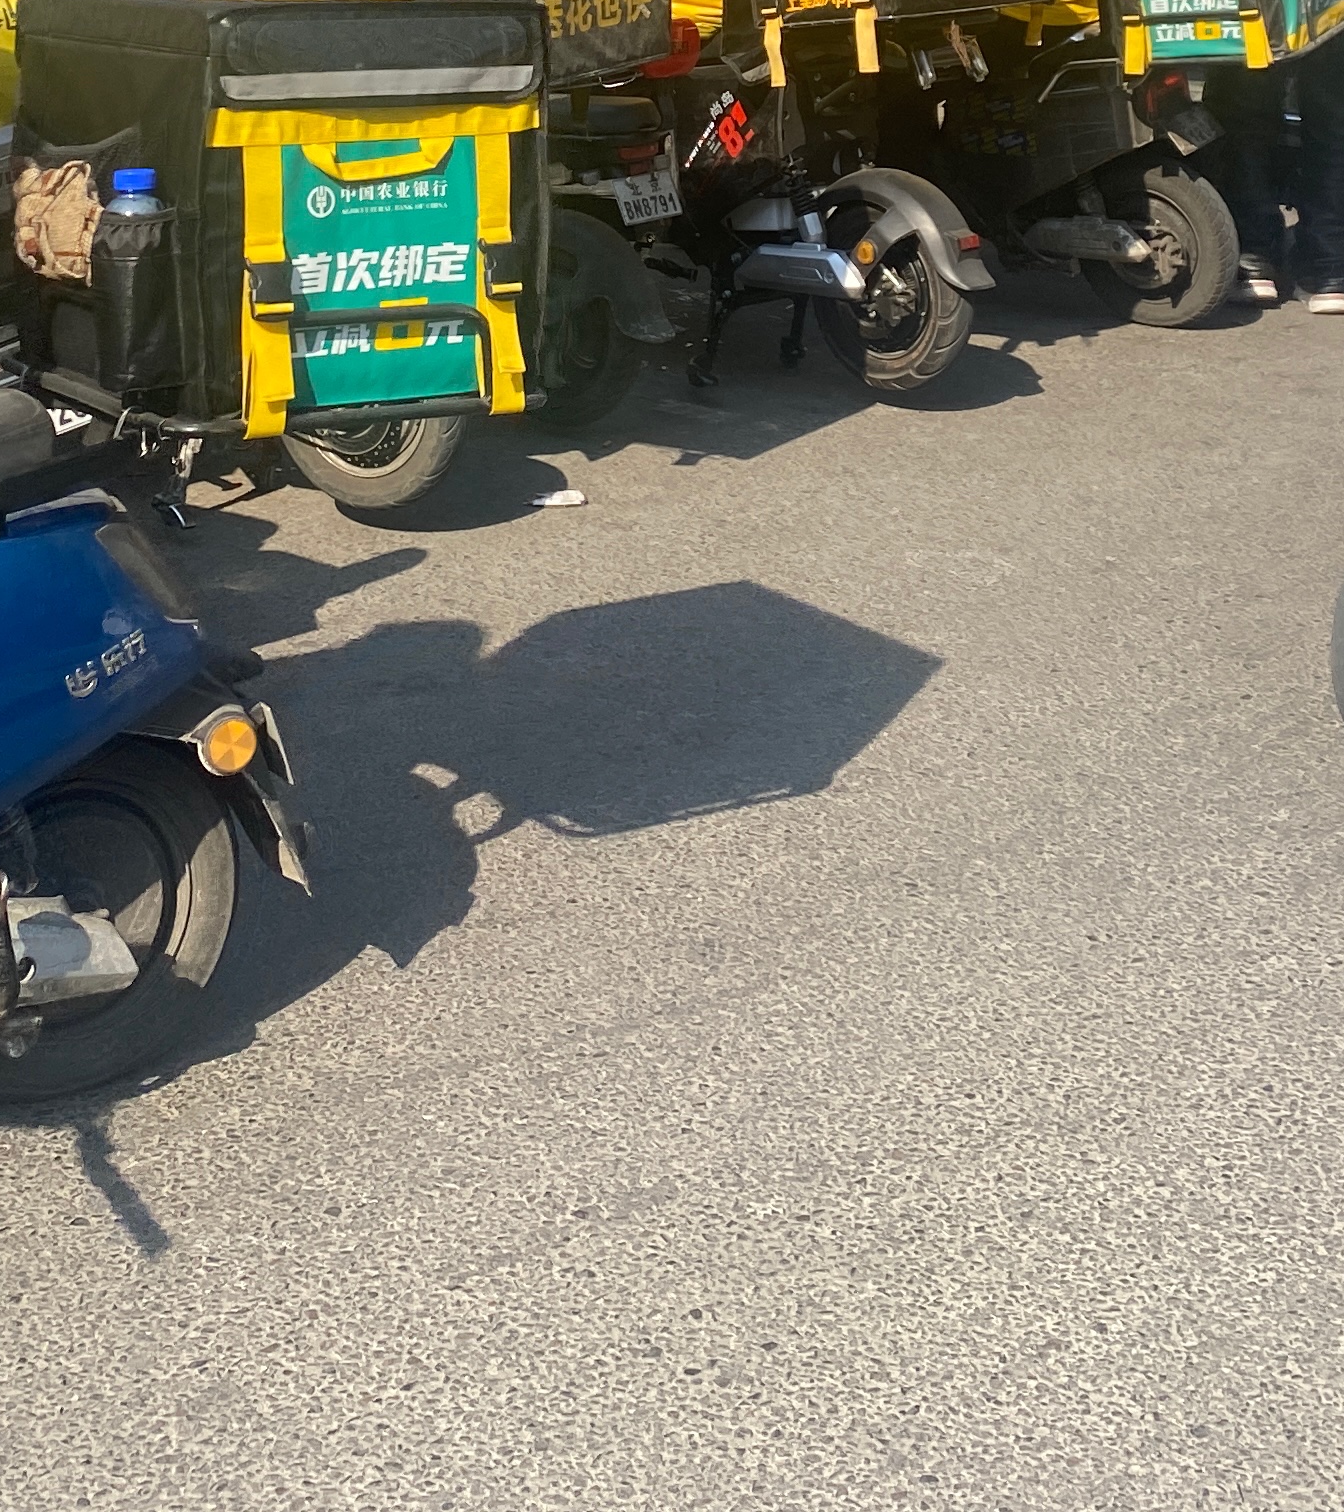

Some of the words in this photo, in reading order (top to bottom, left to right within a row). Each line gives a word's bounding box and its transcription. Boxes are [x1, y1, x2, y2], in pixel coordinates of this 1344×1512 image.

[339, 179, 449, 203] 中国农业银行
[623, 192, 678, 221] BN8791
[291, 242, 470, 295] 首次绑定
